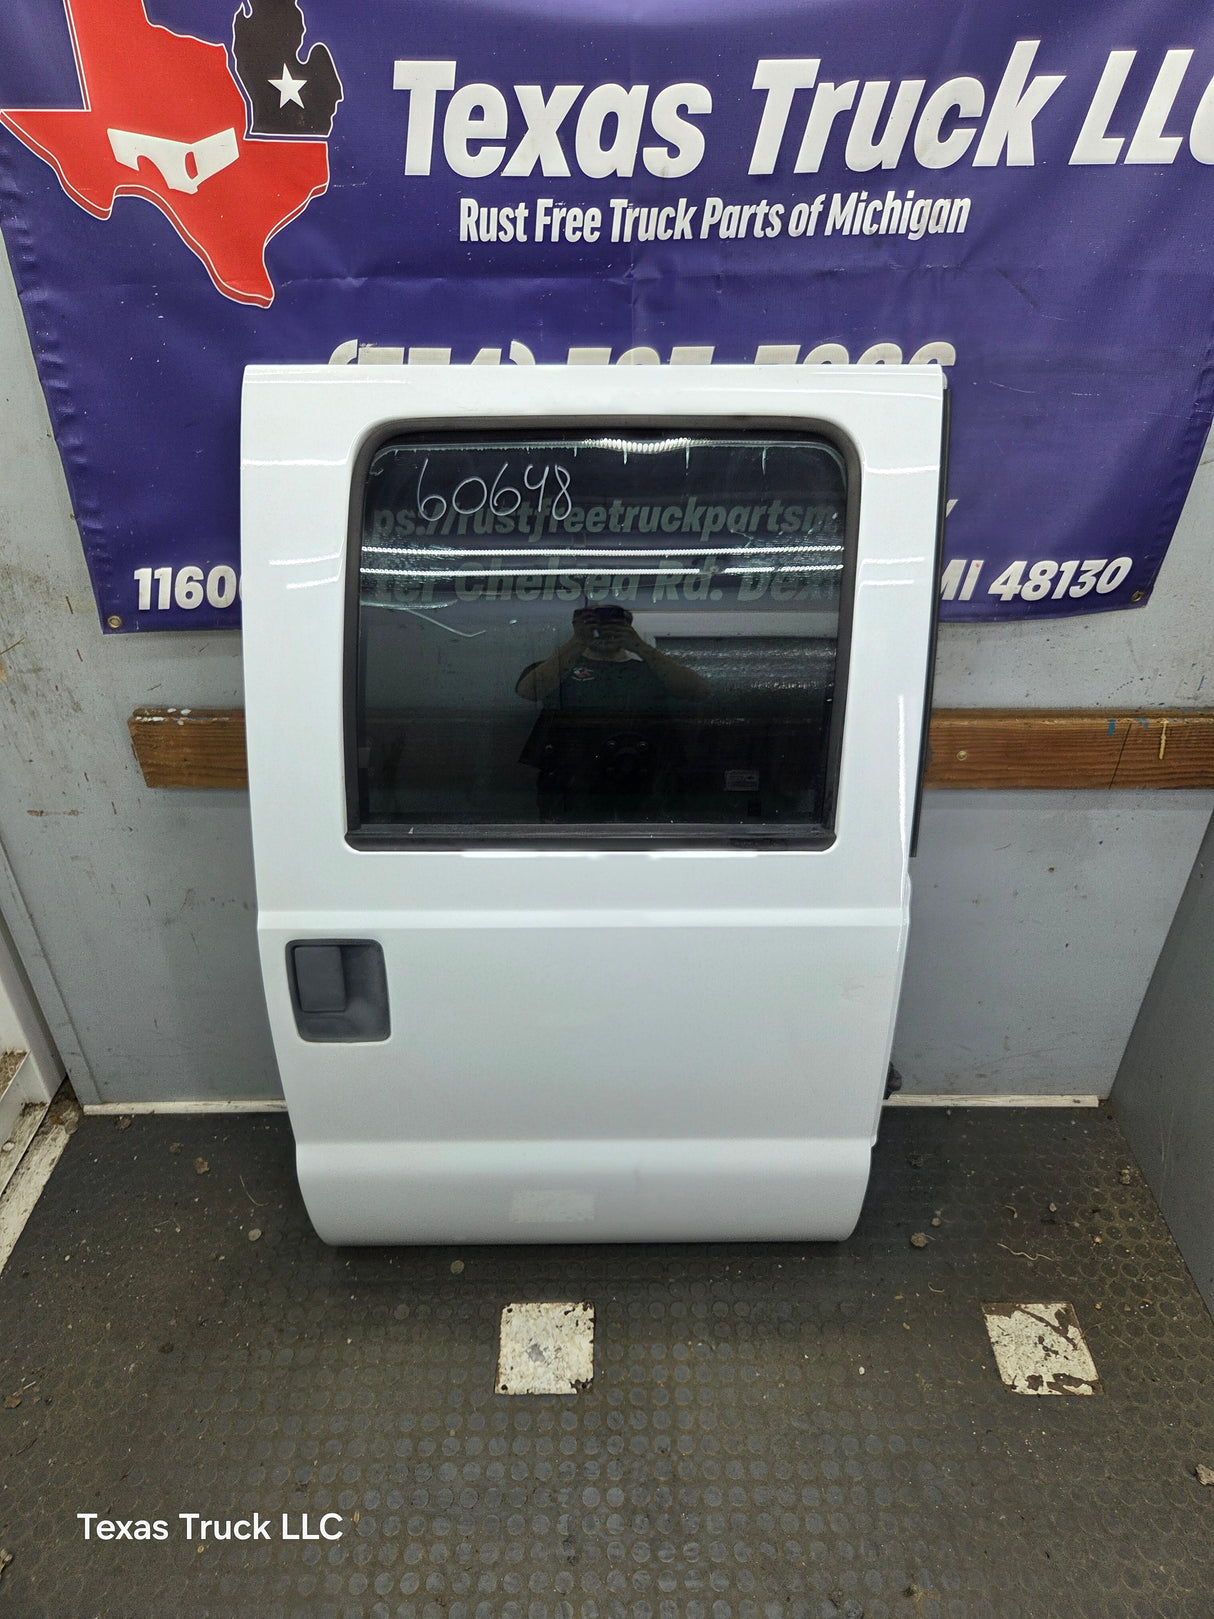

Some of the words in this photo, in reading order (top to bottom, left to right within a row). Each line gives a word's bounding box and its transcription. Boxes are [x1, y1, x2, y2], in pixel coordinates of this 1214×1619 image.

[393, 59, 712, 178] Texas
[748, 40, 1067, 175] Truck
[459, 198, 529, 243] Rust
[534, 198, 602, 243] Free
[609, 197, 698, 242] Truck
[699, 196, 785, 240] Parts
[787, 193, 826, 237] of
[824, 189, 972, 241] Michigan
[416, 457, 573, 522] 60648
[133, 564, 242, 611] 1160
[454, 556, 642, 602] Chelsea
[651, 555, 723, 602] Rd.
[987, 556, 1133, 601] 48130
